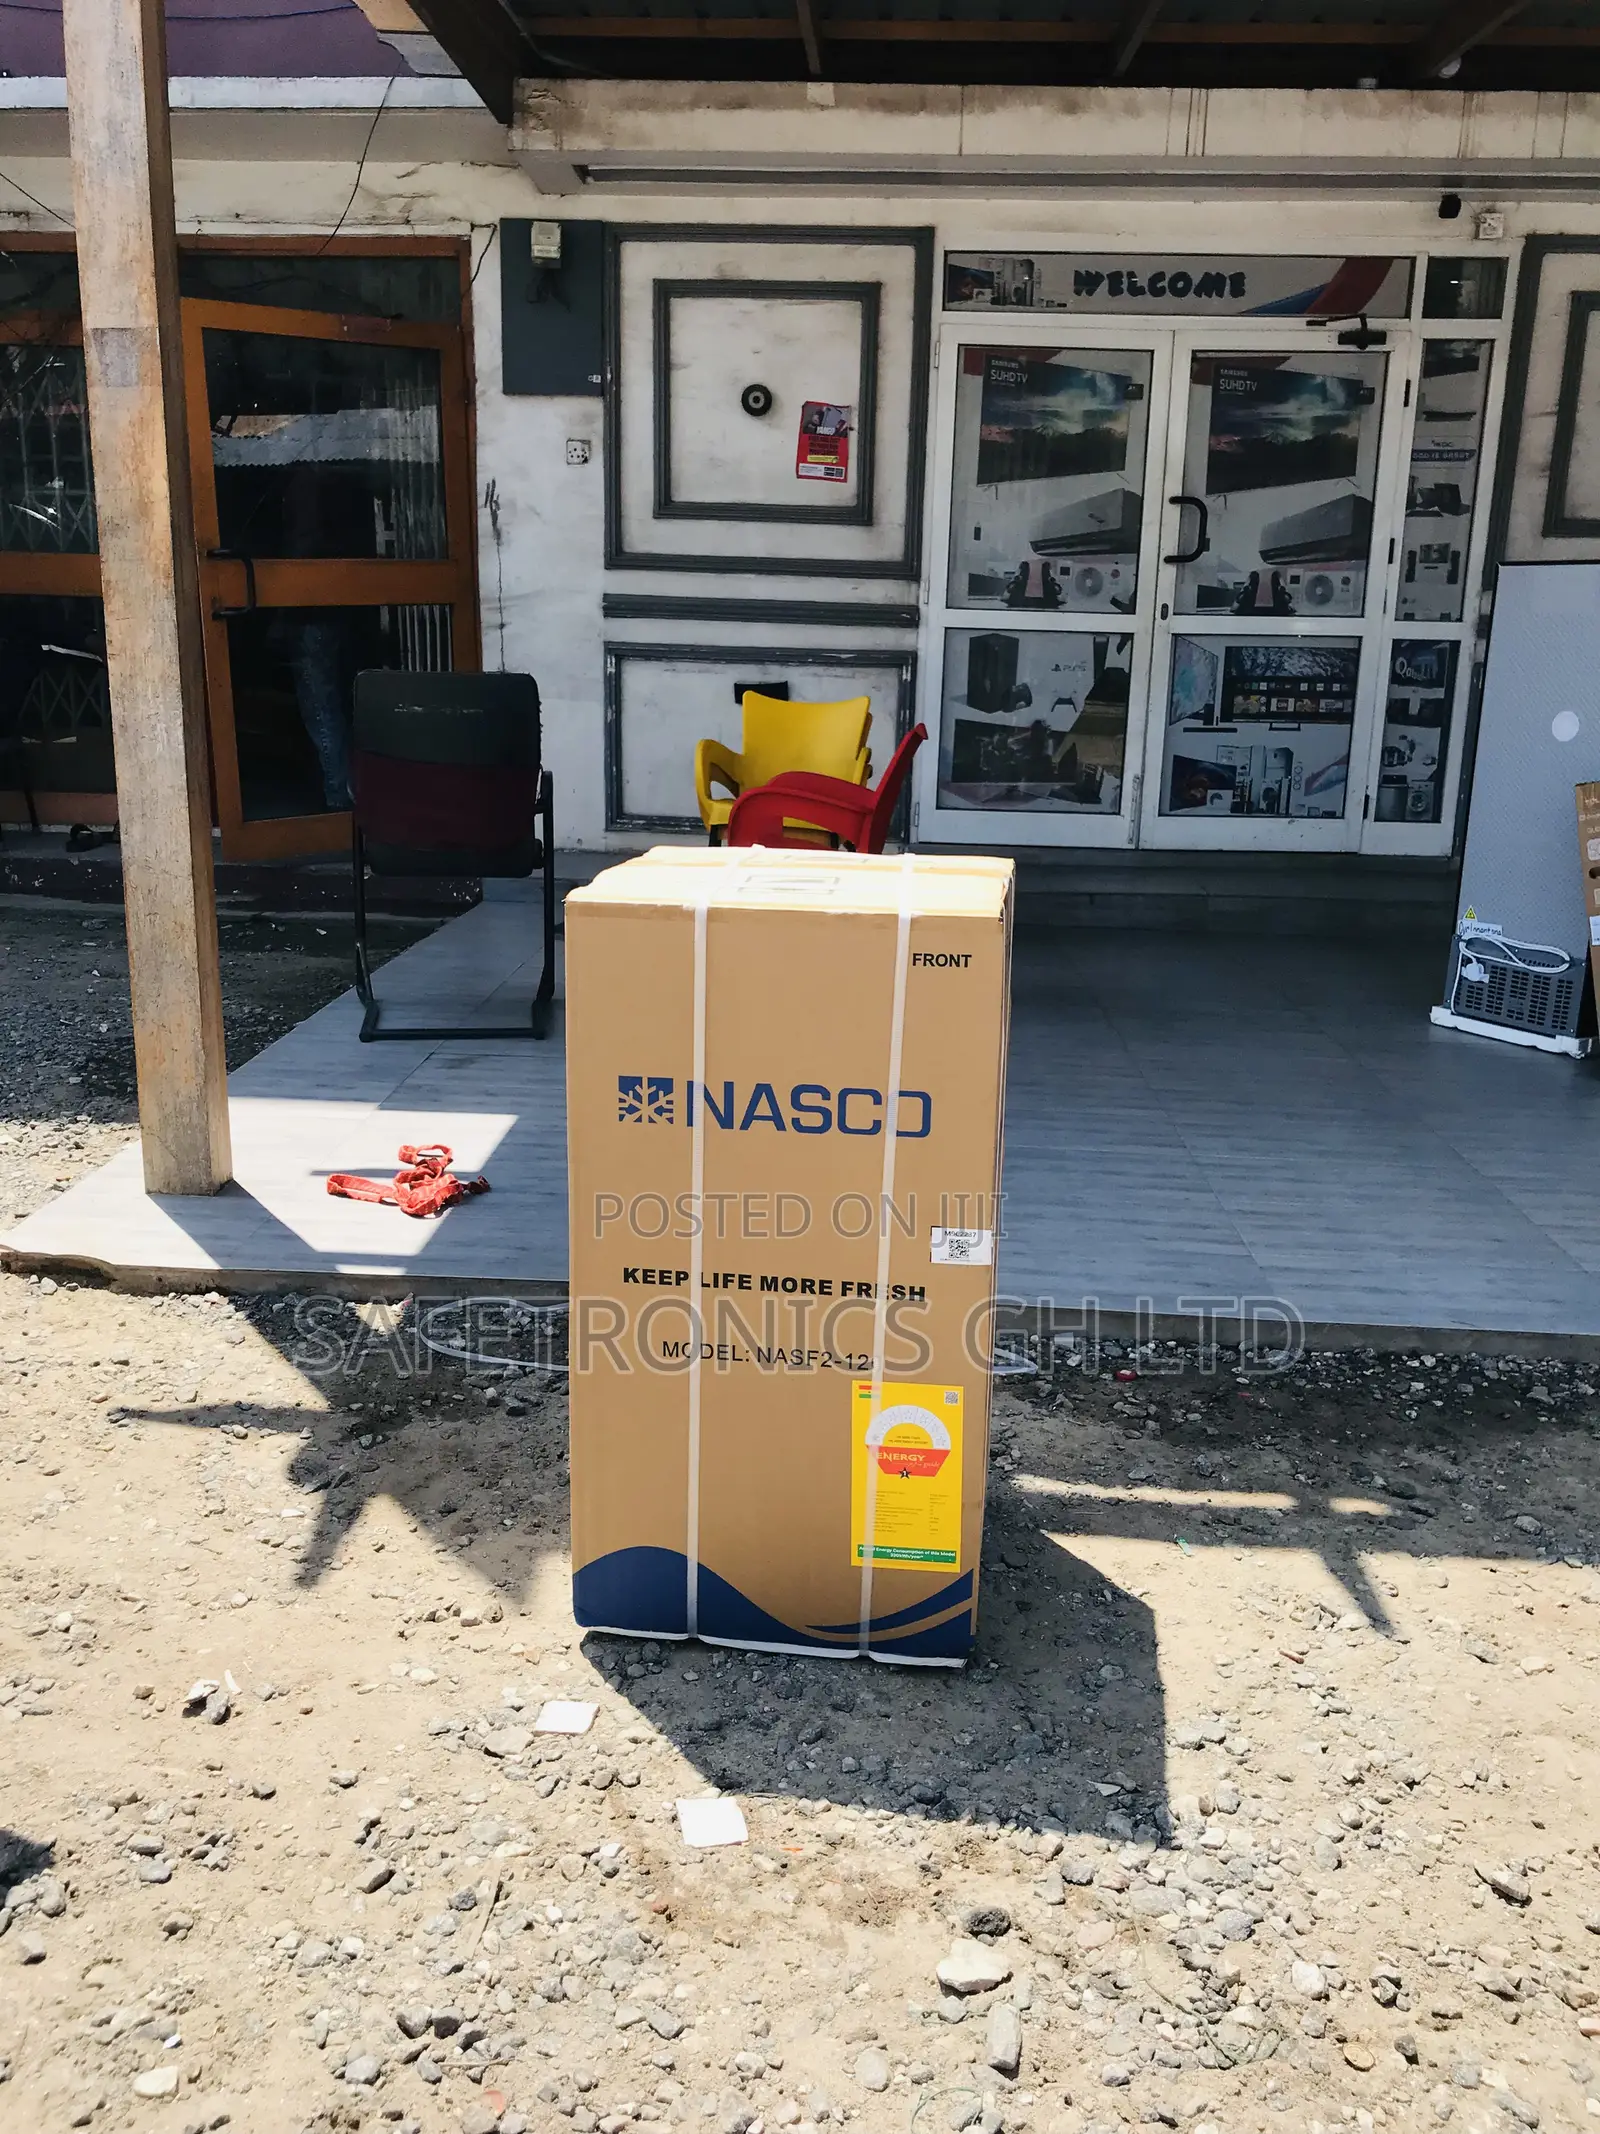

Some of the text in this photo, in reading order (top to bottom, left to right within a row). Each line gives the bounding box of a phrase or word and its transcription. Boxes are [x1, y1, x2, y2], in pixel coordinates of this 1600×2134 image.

[1073, 269, 1246, 299] WELCOME
[911, 952, 972, 968] FRONT
[686, 1080, 932, 1138] NASCO
[623, 1267, 690, 1286] KEEP
[760, 1275, 833, 1296] MORE
[841, 1281, 926, 1302] FRSH
[757, 1347, 880, 1372] NASF2-12
[876, 1451, 927, 1462] ENERGY
